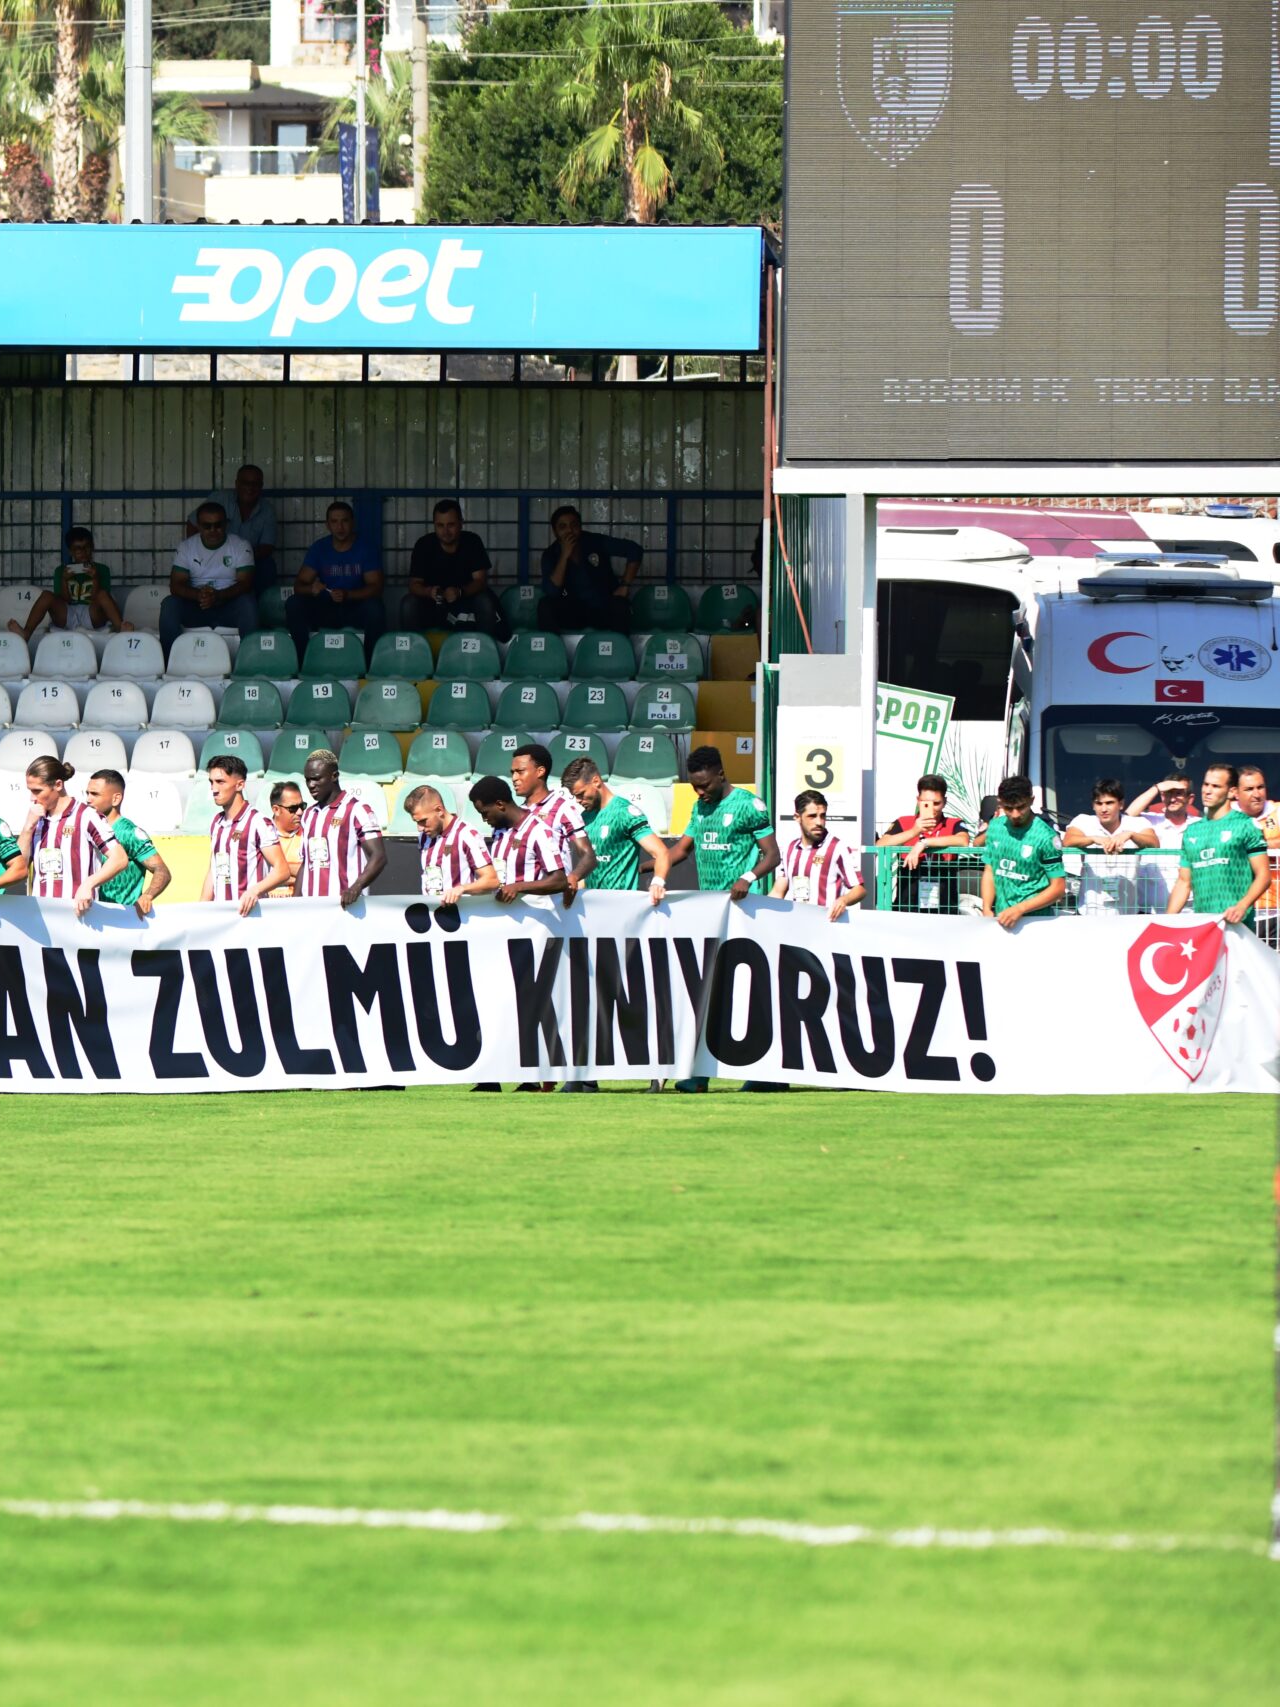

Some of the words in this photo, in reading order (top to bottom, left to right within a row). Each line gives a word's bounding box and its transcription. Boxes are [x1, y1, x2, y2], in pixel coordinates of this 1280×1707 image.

[1011, 15, 1223, 100] 00:00
[949, 184, 1005, 336] 0
[1223, 183, 1279, 336] 0
[171, 239, 484, 337] opet
[18, 591, 31, 601] 14
[724, 587, 735, 596] 24
[62, 640, 71, 648] 16
[127, 639, 141, 649] 17
[329, 638, 340, 646] 20
[399, 640, 409, 648] 21
[462, 641, 477, 650] 22
[533, 640, 543, 649] 23
[600, 644, 610, 653] 24
[41, 687, 59, 698] 15
[111, 689, 122, 697] 16
[181, 689, 192, 698] 17
[246, 689, 257, 698] 18
[314, 686, 329, 697] 19
[384, 688, 396, 697] 20
[453, 685, 464, 695] 21
[658, 690, 669, 699] 24
[523, 691, 534, 701] 22
[590, 690, 604, 701] 23
[23, 738, 34, 747] 15
[90, 739, 101, 747] 16
[159, 740, 170, 749] 17
[226, 736, 237, 745] 18
[297, 738, 307, 746] 19
[366, 738, 378, 747] 20
[434, 737, 446, 746] 21
[504, 738, 516, 747] 22
[569, 738, 587, 750] 23
[640, 739, 652, 749] 24
[741, 740, 749, 750] 4
[804, 748, 834, 789] 3
[131, 903, 482, 1079] ZULMÜ
[507, 937, 997, 1082] KINIYORUZ!
